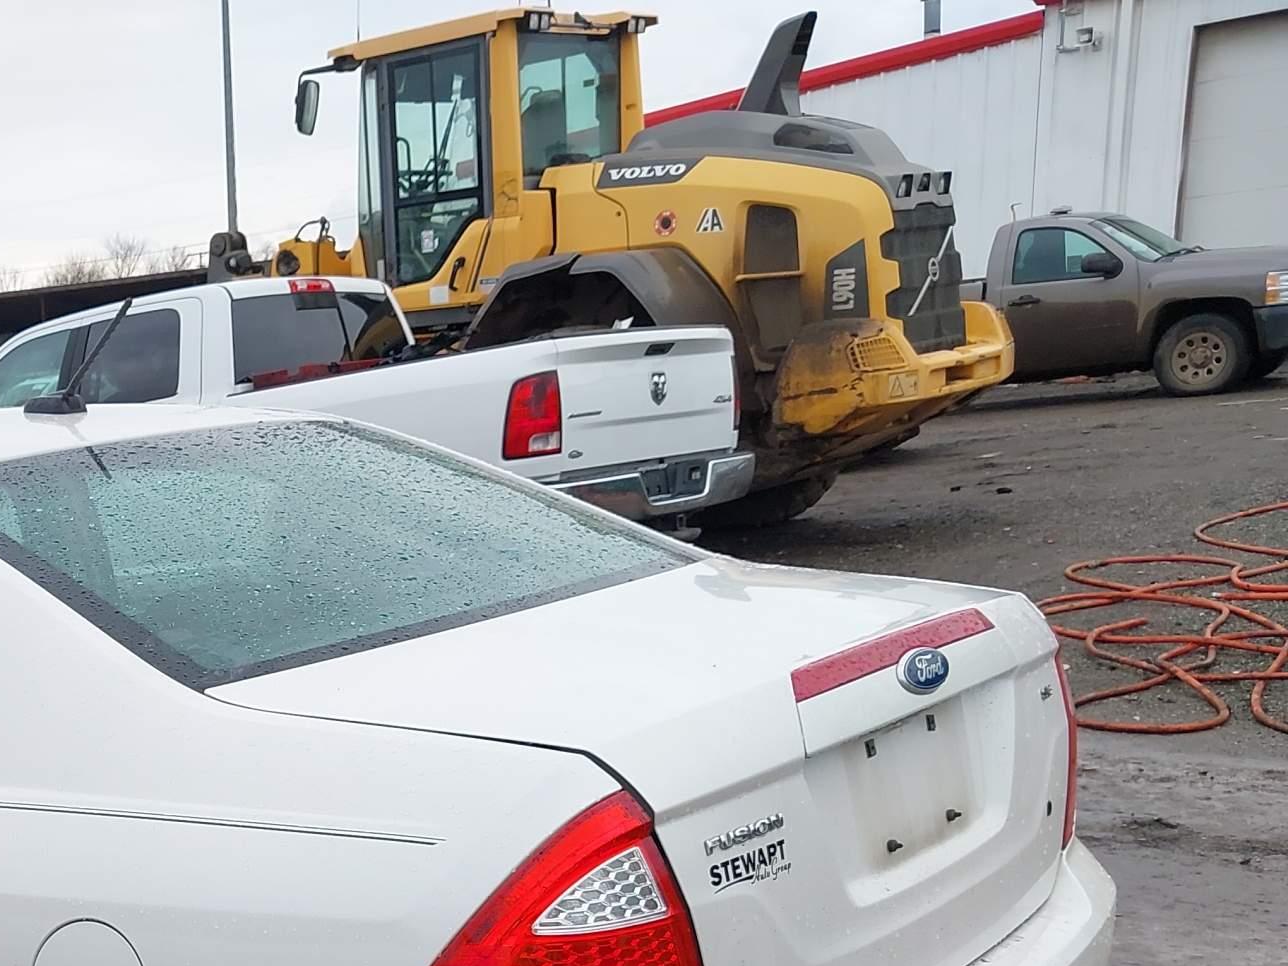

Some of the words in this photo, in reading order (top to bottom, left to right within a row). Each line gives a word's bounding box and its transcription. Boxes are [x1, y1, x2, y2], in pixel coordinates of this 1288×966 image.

[608, 163, 686, 181] VOLVO
[832, 267, 856, 311] L90H
[915, 653, 944, 682] Ford
[704, 813, 784, 856] FUSION
